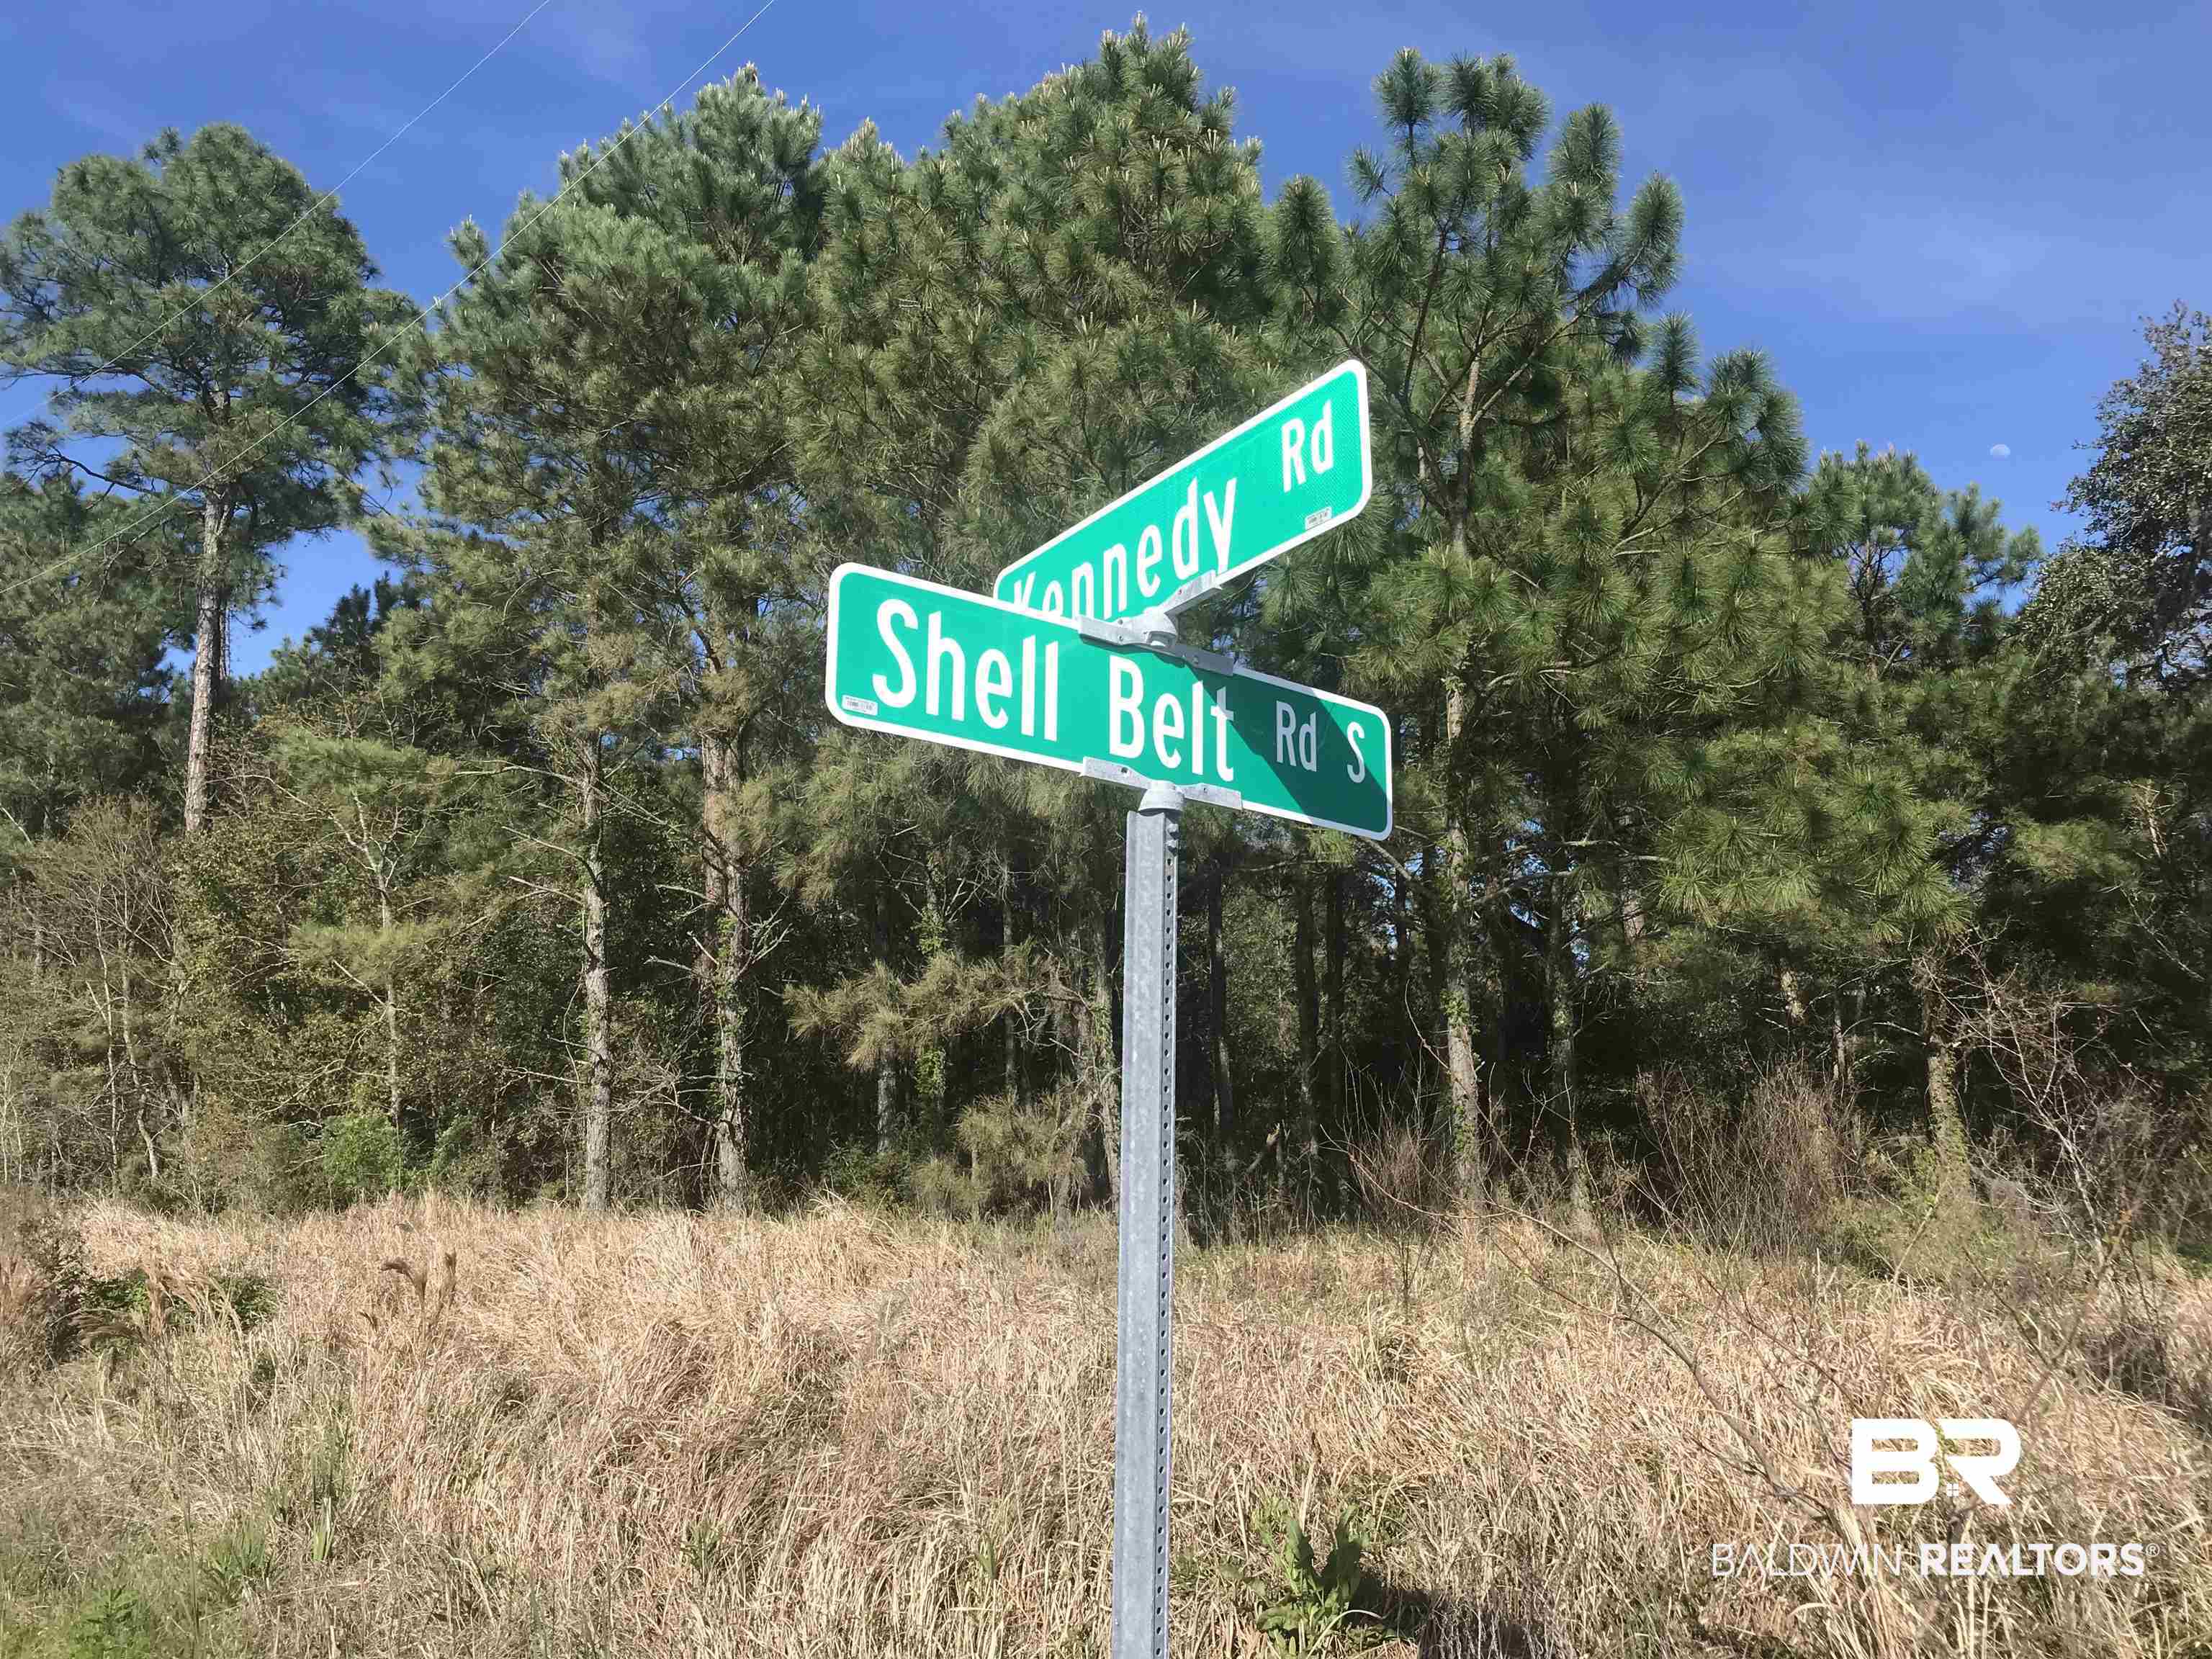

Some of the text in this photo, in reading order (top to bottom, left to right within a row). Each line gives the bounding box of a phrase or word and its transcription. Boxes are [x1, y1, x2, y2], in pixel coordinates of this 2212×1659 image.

[1281, 400, 1334, 493] Rd
[872, 598, 1365, 783] Shell Belt Rd S
